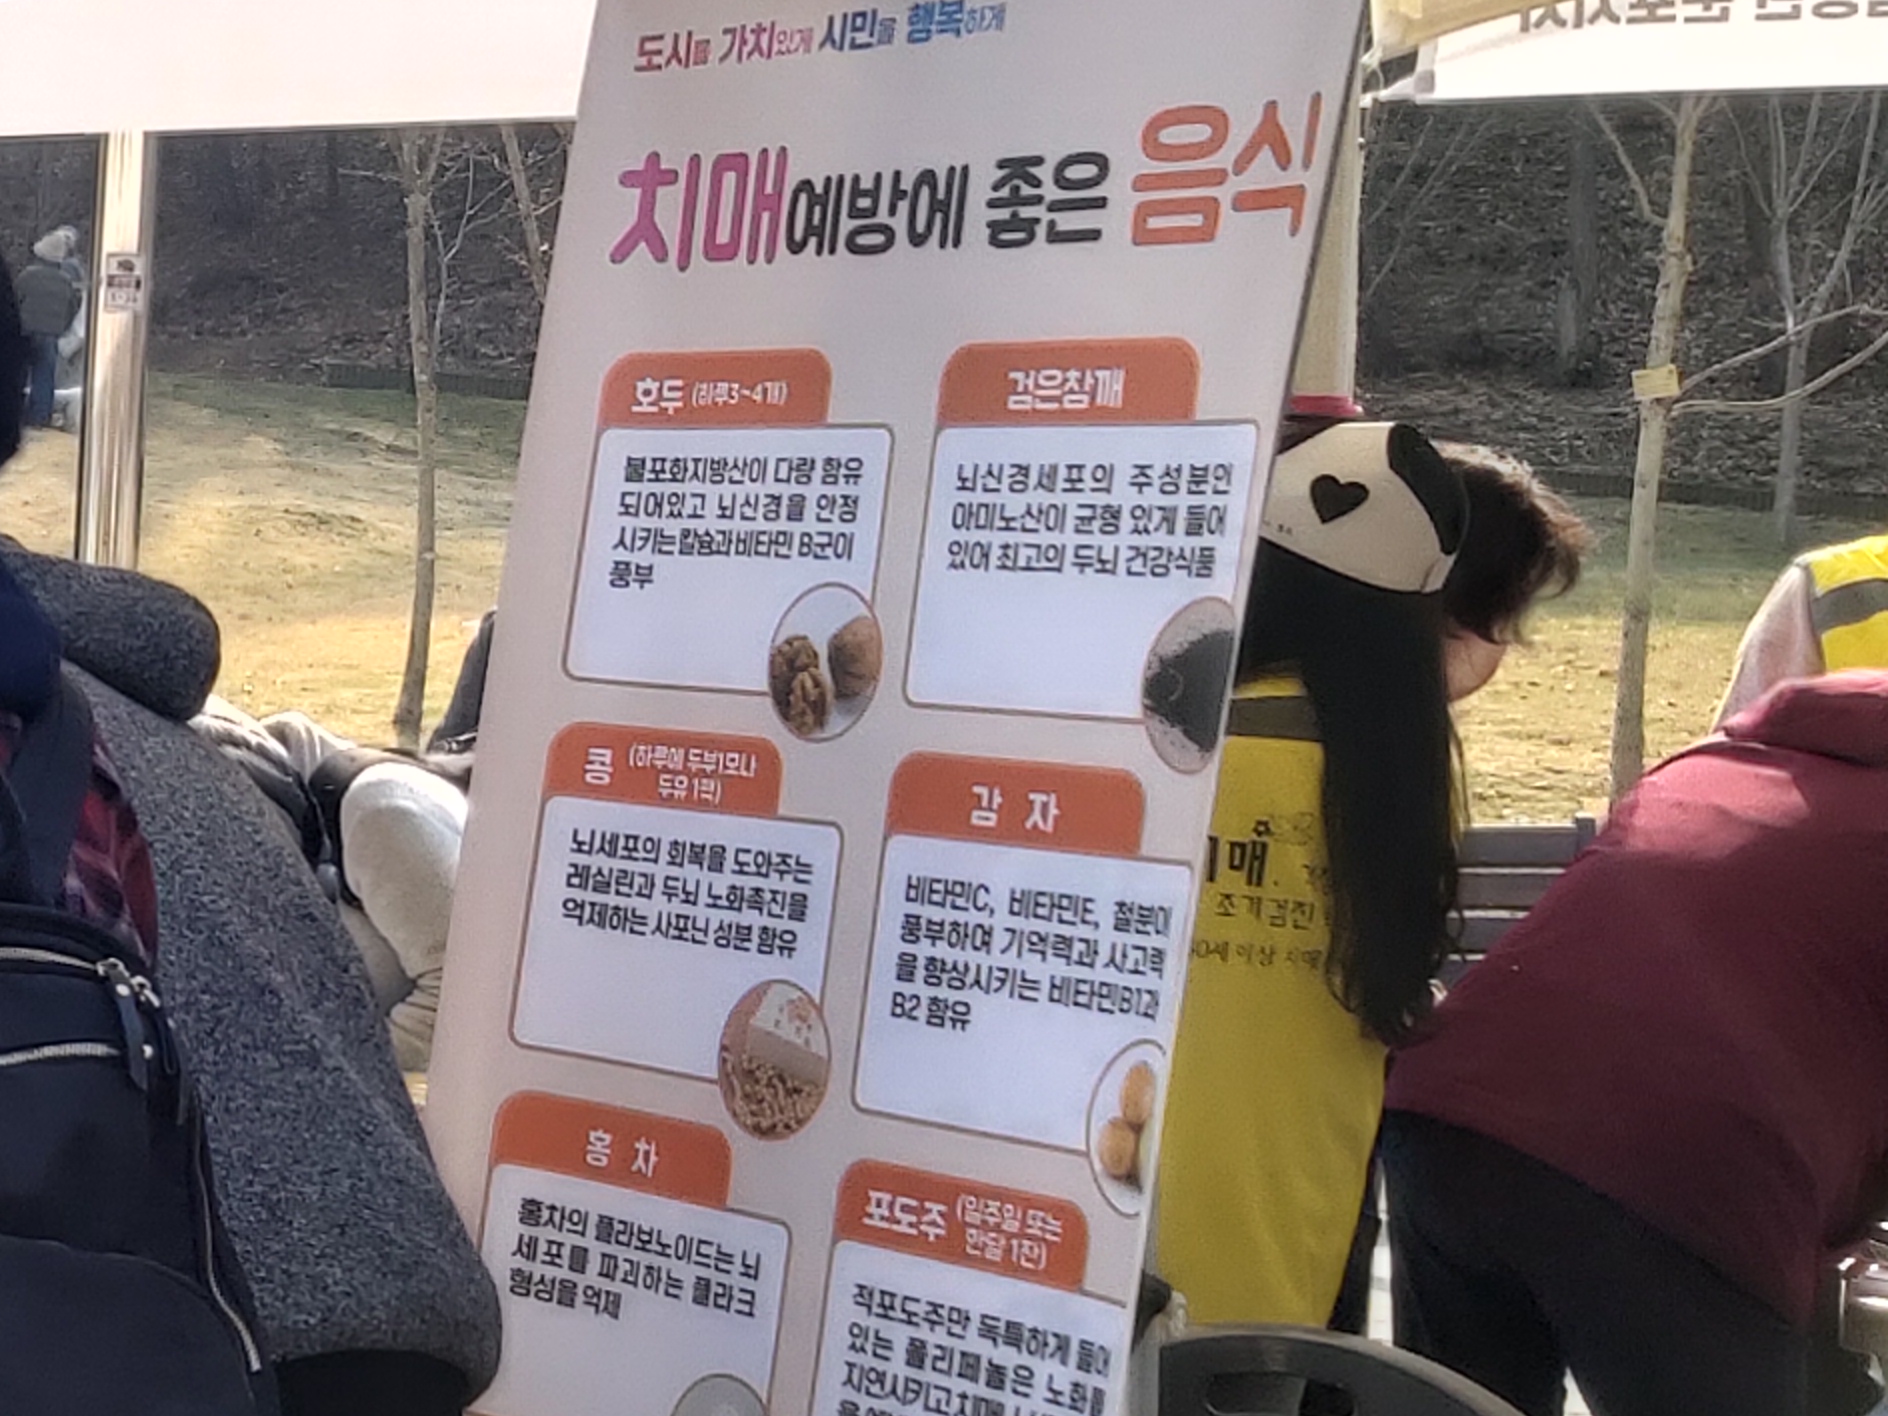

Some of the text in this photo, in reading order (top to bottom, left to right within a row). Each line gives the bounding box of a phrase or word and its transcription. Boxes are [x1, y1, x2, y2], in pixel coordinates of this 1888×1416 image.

[718, 20, 813, 64] 가치있게
[819, 9, 895, 53] 시민을
[610, 90, 1322, 273] 치매예방에 좋은 음식
[631, 377, 683, 415] 호두
[1006, 367, 1125, 410] 검은참깨
[624, 456, 863, 485] 불포화지방산이 다량 함유
[956, 463, 1232, 496] 뇌신경세포의 주성분인
[618, 490, 858, 523] 되어있고 뇌신경을 안정
[952, 502, 1066, 534] 아미노산이
[1074, 504, 1121, 536] 균형
[1129, 506, 1177, 536] 있게
[1184, 506, 1226, 537] 들어
[612, 526, 854, 561] 시키는 비타민 B군이
[947, 540, 1216, 578] 있어 최고의 두뇌 건강식품
[609, 560, 654, 590] 풍부
[584, 747, 614, 785] 콩
[570, 828, 813, 885] 뇌세포의 회복을 도와주는
[661, 875, 700, 907] 두뇌
[705, 884, 808, 923] 노화촉진을
[905, 874, 1100, 931] 비타민C, 비타민E,
[561, 897, 798, 959] 억제하는 사포닌 성분 함유
[900, 913, 993, 955] 풍부하여
[1000, 928, 1098, 971] 기억력과
[895, 952, 918, 983] 을
[923, 959, 1041, 1003] 향상시키는
[891, 992, 972, 1033] B2 함유
[517, 1197, 761, 1282] 홍차의 플라보노이드는 뇌
[862, 1188, 948, 1242] 포도주
[508, 1267, 622, 1321] 형성을 억제
[510, 1234, 757, 1319] 세포를 파괴하는 플라크
[852, 1283, 1071, 1368] 적포도주만 독특하게
[847, 1321, 1035, 1399] 있는 폴리페놀은
